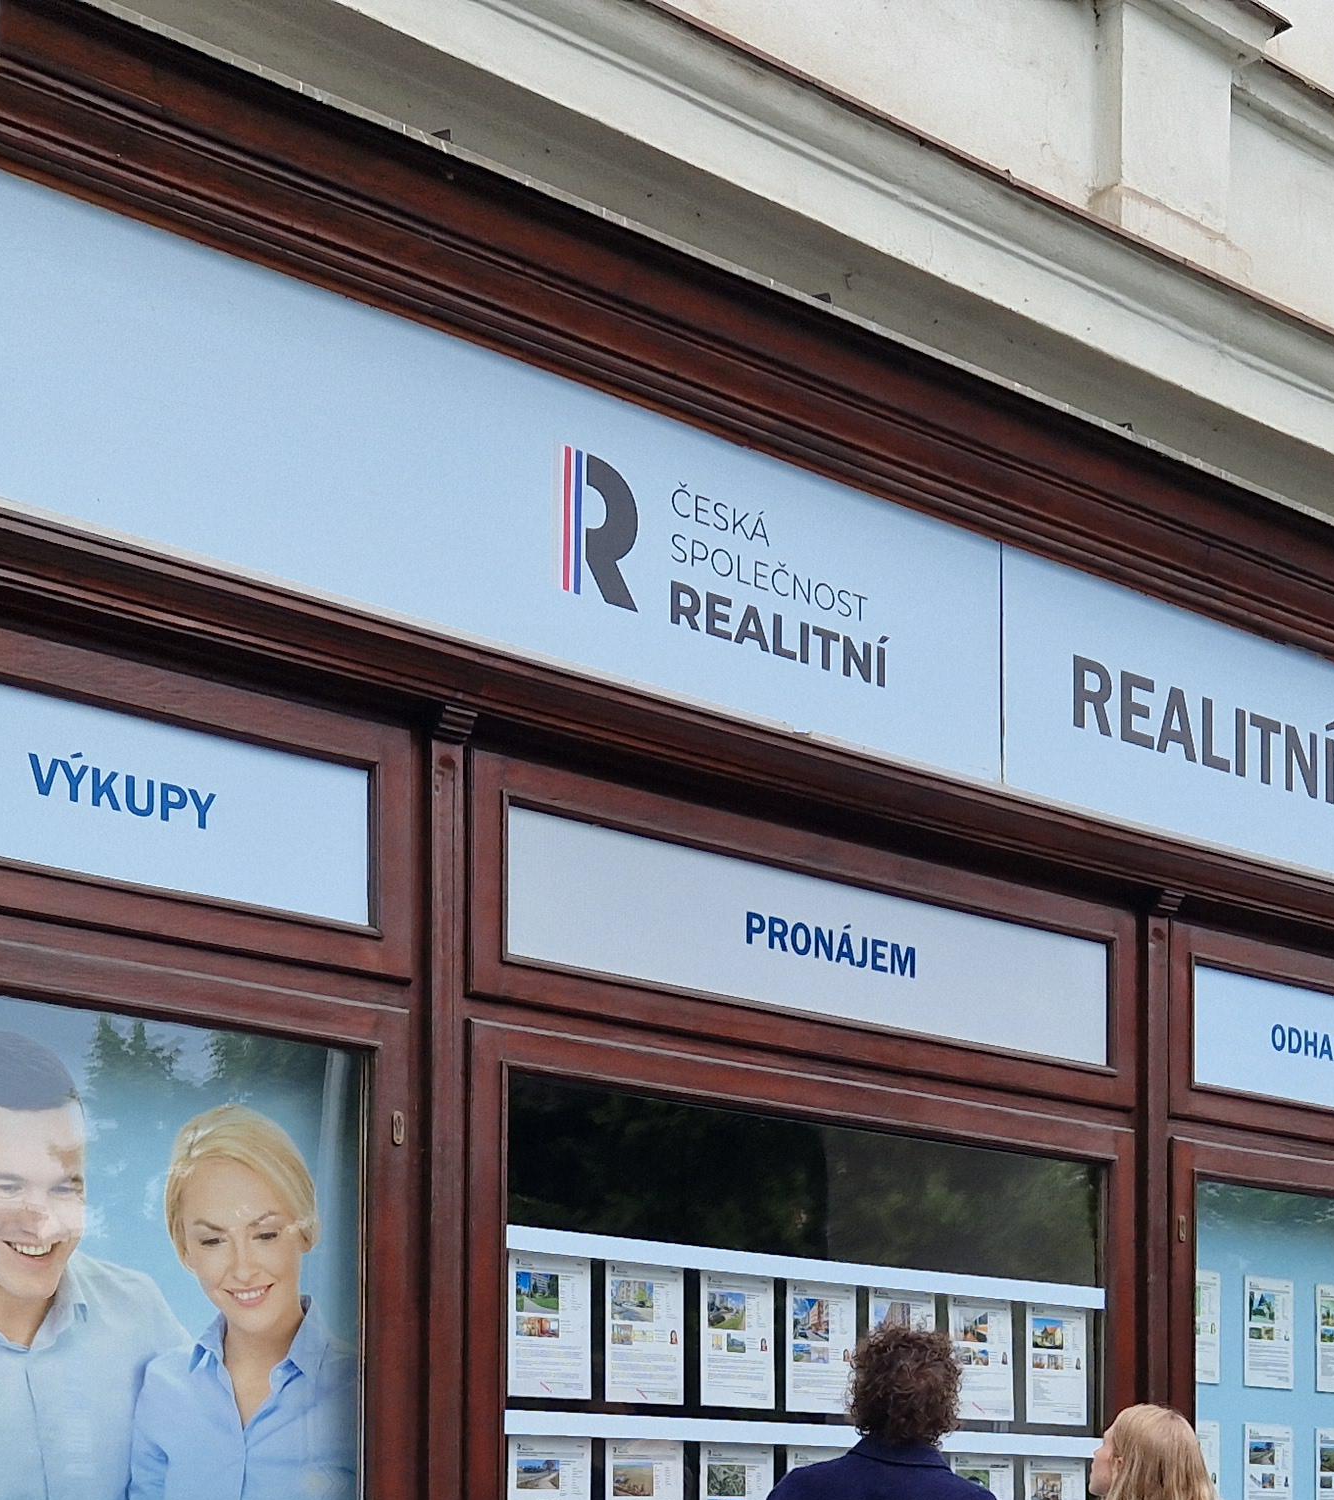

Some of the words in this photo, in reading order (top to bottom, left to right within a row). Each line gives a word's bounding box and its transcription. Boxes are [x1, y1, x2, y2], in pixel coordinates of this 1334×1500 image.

[671, 481, 769, 547] ČESKÁ
[671, 533, 868, 622] SPOLEČNOST
[670, 579, 890, 688] REALITNÍ
[27, 751, 217, 830] VÝKUPY
[746, 911, 916, 979] PRONÁJEM
